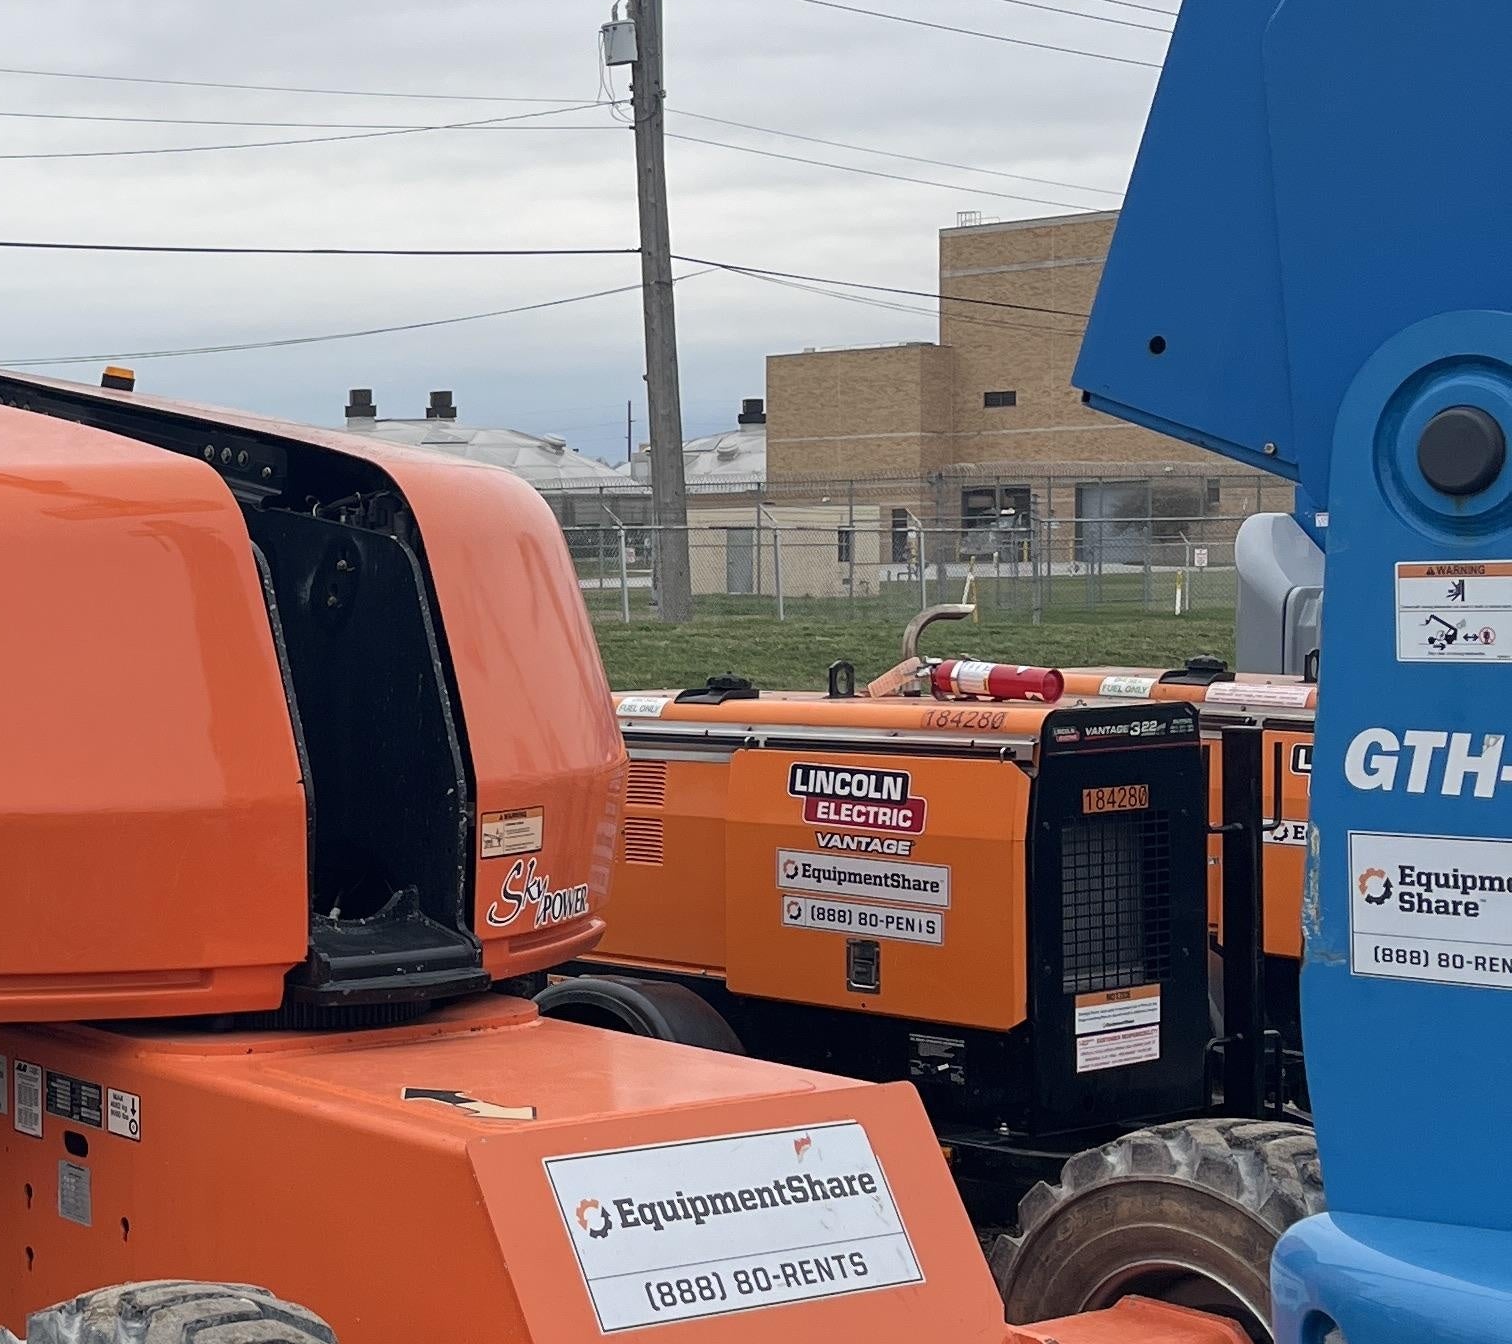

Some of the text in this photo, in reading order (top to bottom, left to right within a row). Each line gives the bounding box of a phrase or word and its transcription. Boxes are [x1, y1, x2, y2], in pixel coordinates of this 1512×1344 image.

[1437, 565, 1486, 575] WARNING
[925, 710, 1006, 730] 184280
[794, 768, 903, 801] LINCOLN
[1085, 786, 1148, 811] 184280
[816, 801, 912, 828] ELECTRIC
[816, 832, 912, 856] VANTAGE
[801, 863, 940, 893] EquipmentShare
[811, 905, 853, 926] (888)
[1399, 892, 1479, 917] Share
[1374, 945, 1429, 968] (888)
[613, 1171, 877, 1232] EquipmentShare
[645, 1252, 869, 1311] (888) 80-RENTS
